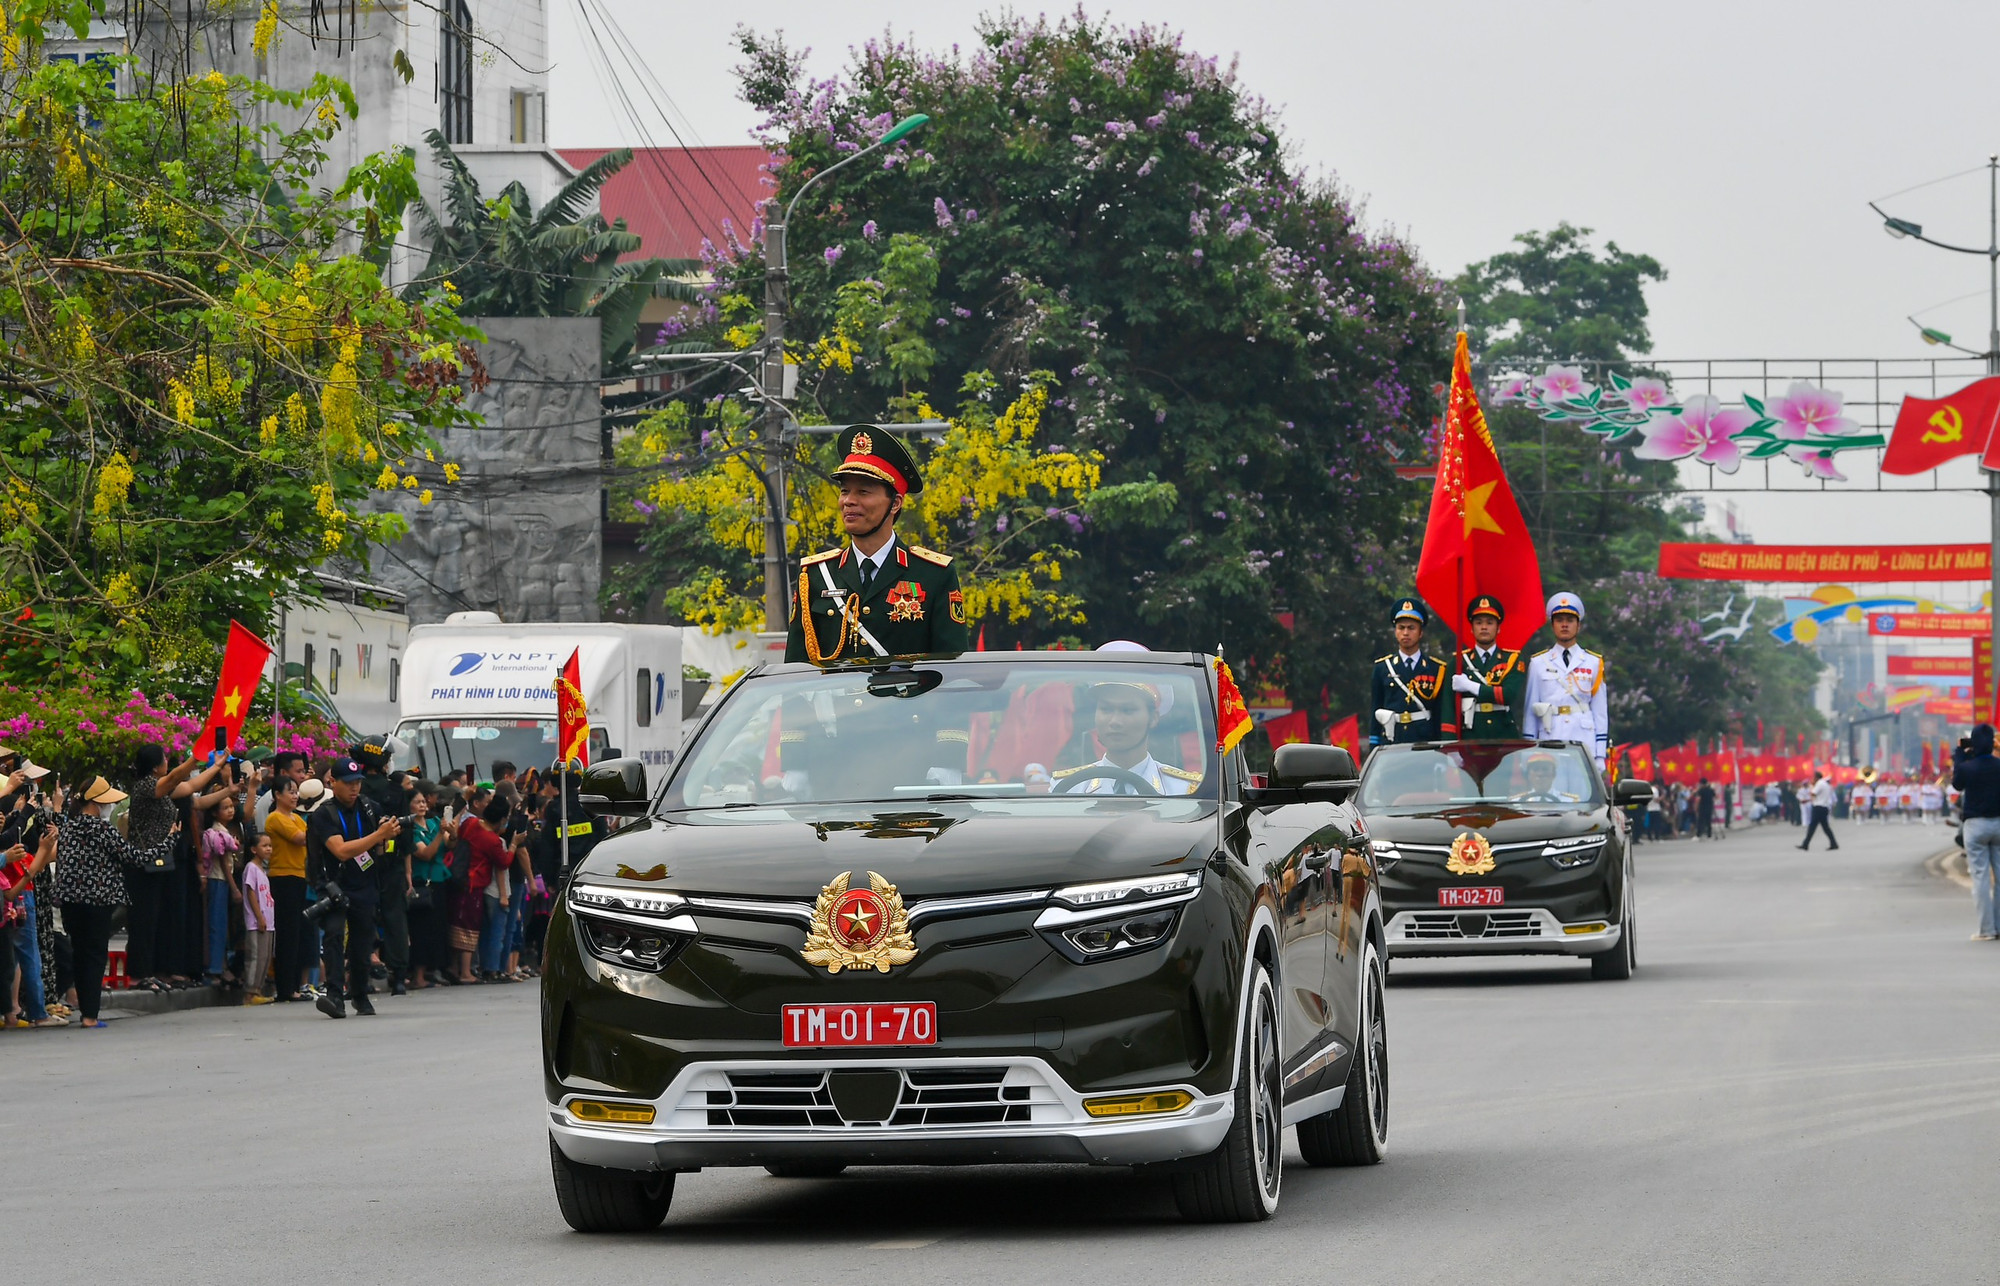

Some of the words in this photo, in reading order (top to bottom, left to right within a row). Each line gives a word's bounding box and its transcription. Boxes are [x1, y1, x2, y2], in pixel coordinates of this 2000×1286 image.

[1698, 550, 1738, 569] CHIẾN
[1740, 550, 1783, 570] THẮNG
[1852, 549, 1880, 571] PHỦ
[431, 685, 462, 699] PHÁT
[465, 685, 494, 699] HÌNH
[524, 685, 557, 701] ĐỘNG
[459, 720, 518, 728] MITSUBISHI
[1441, 889, 1501, 904] TM-02-70
[788, 1007, 930, 1042] TM-01-70
